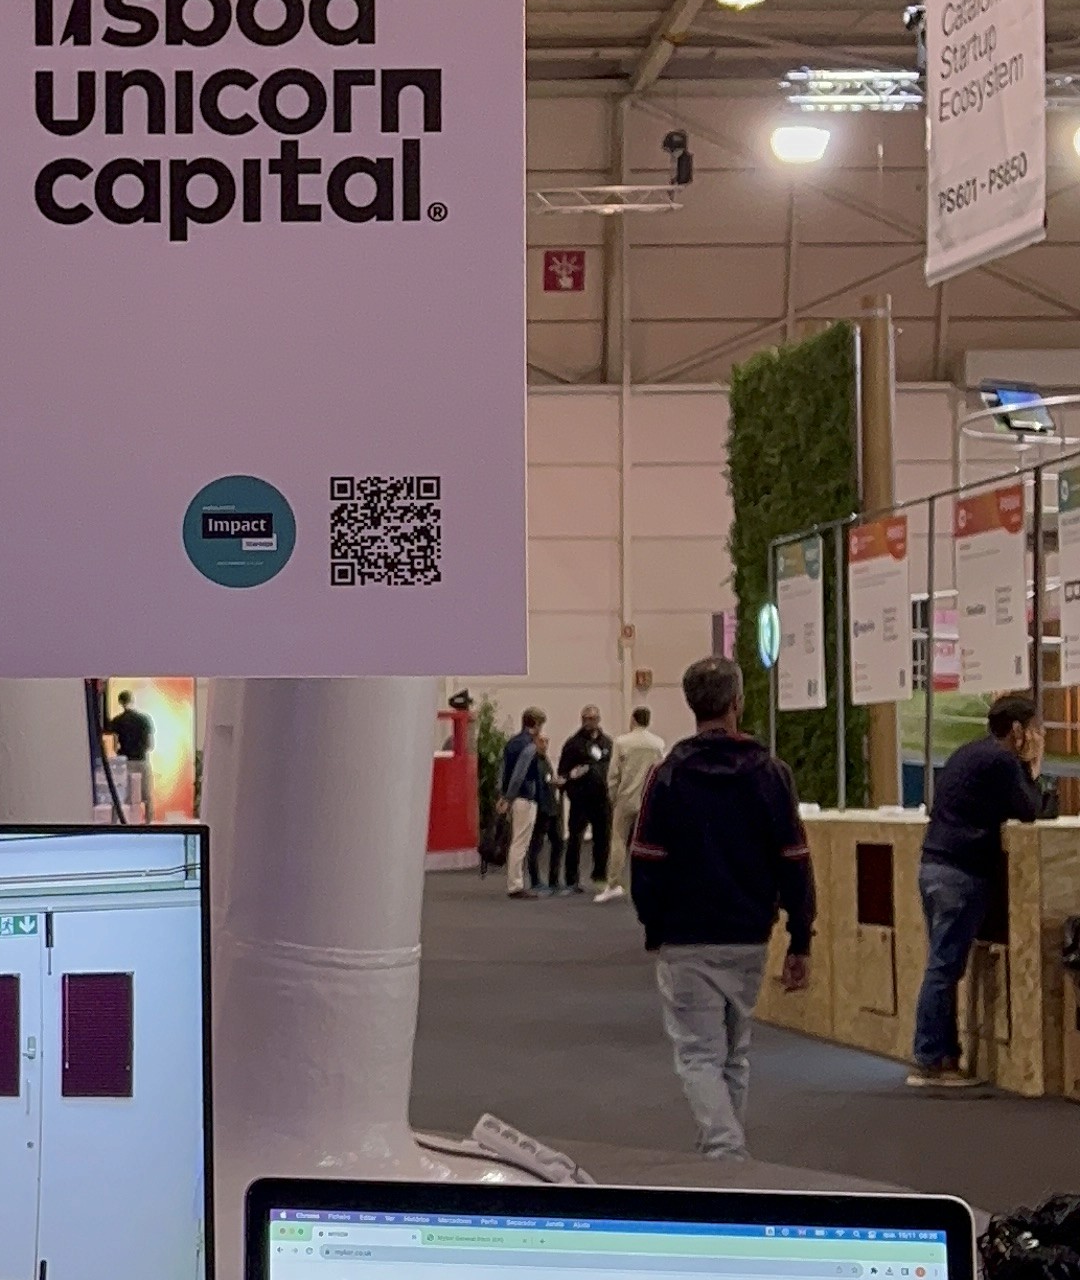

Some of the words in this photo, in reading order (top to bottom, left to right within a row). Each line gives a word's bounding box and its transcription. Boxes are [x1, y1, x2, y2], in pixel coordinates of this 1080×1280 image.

[940, 24, 997, 79] Startup
[35, 68, 441, 136] unicorn
[938, 53, 1024, 122] Ecosystem
[209, 519, 267, 535] Impact
